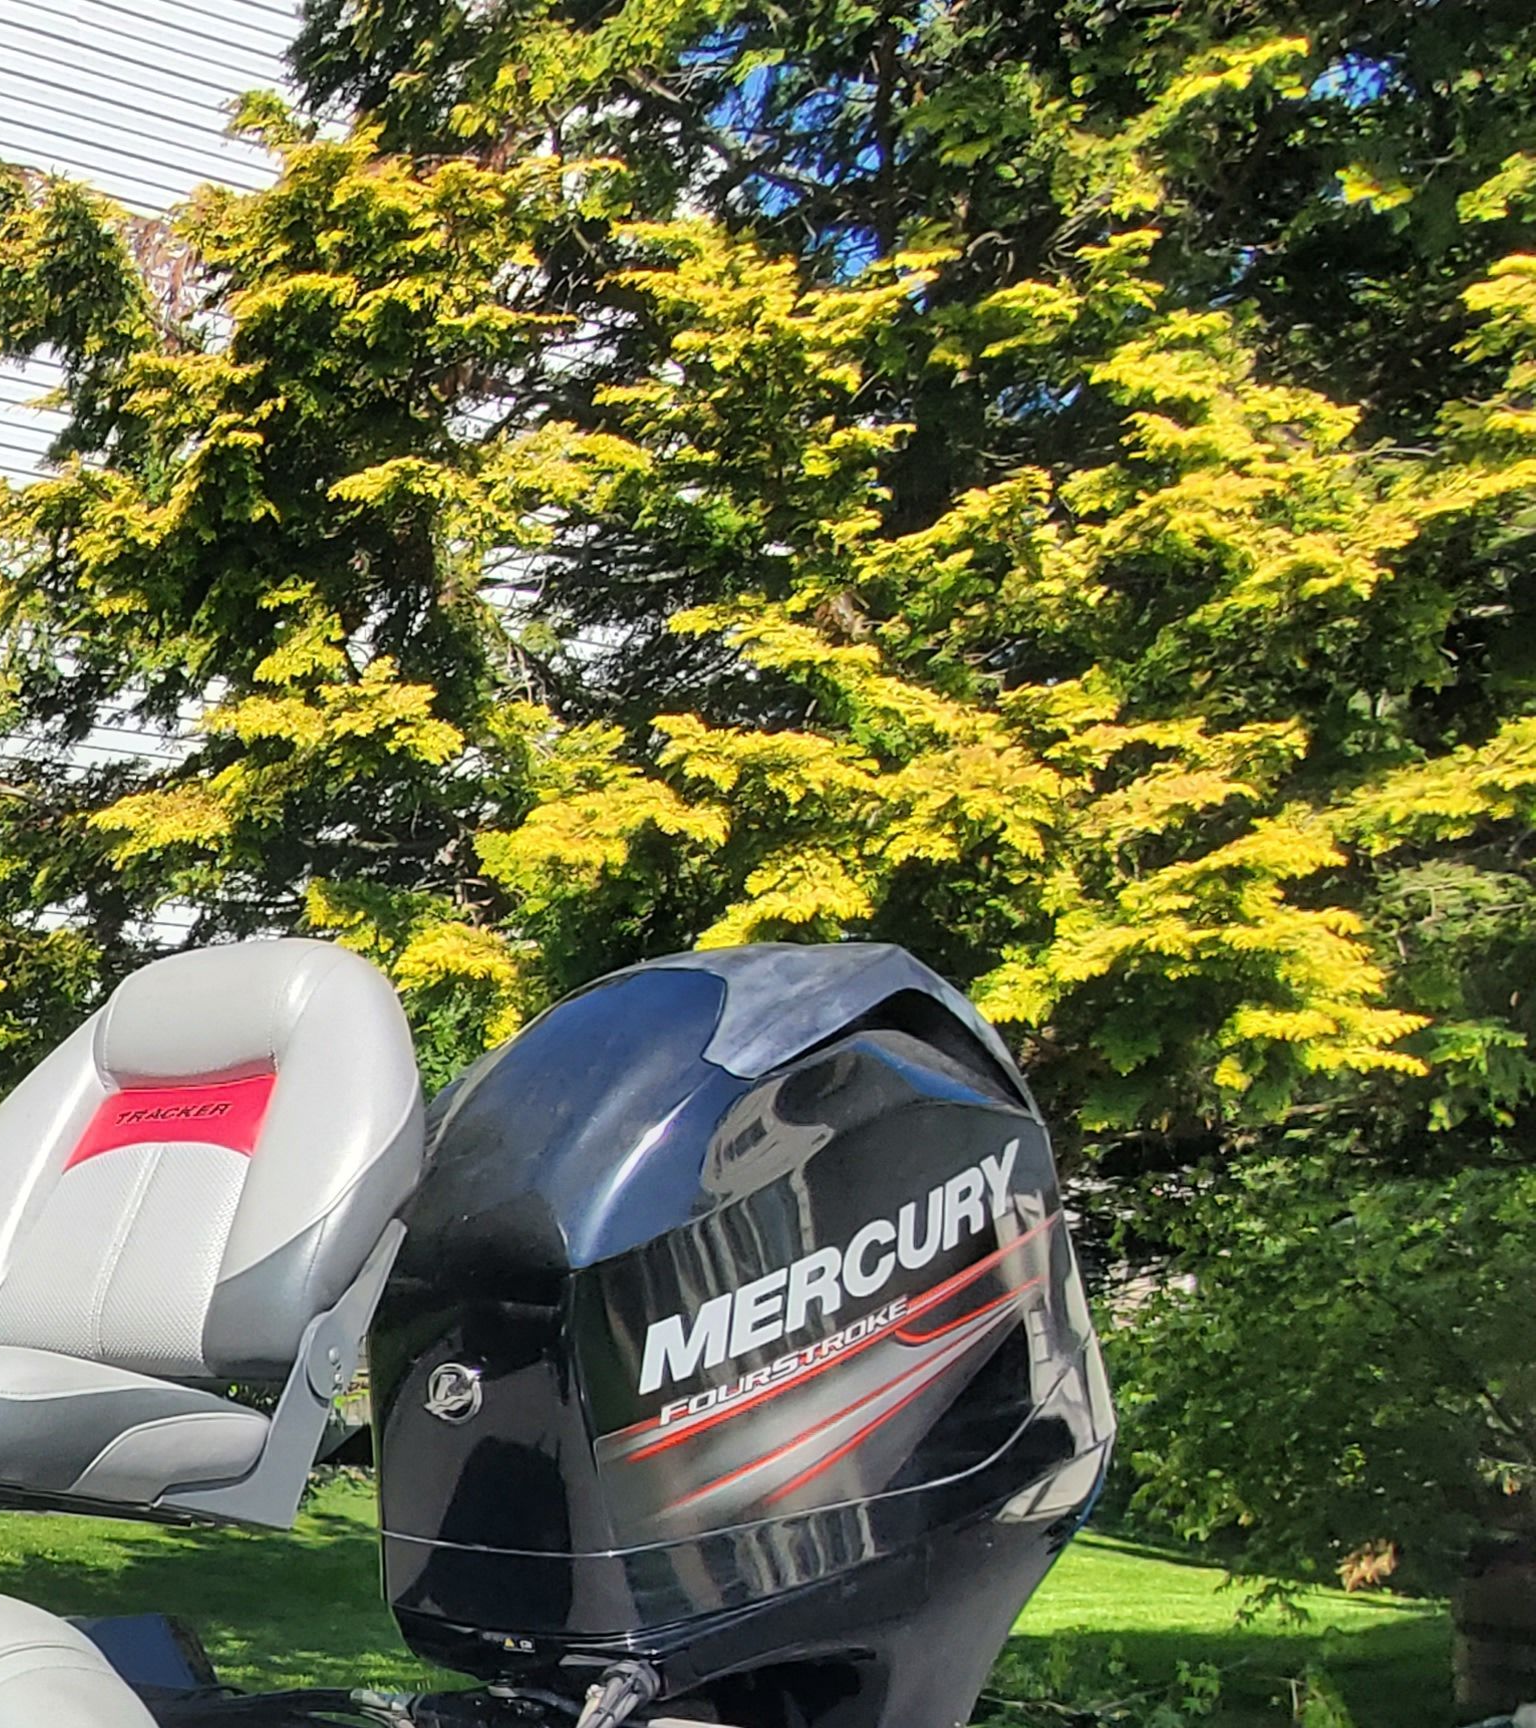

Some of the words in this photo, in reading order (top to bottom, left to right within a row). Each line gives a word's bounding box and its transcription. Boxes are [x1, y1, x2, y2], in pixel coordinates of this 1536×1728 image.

[115, 1102, 230, 1127] TRACKER
[639, 1138, 1020, 1396] MERCURY
[659, 1295, 911, 1427] FOURSTROKE
